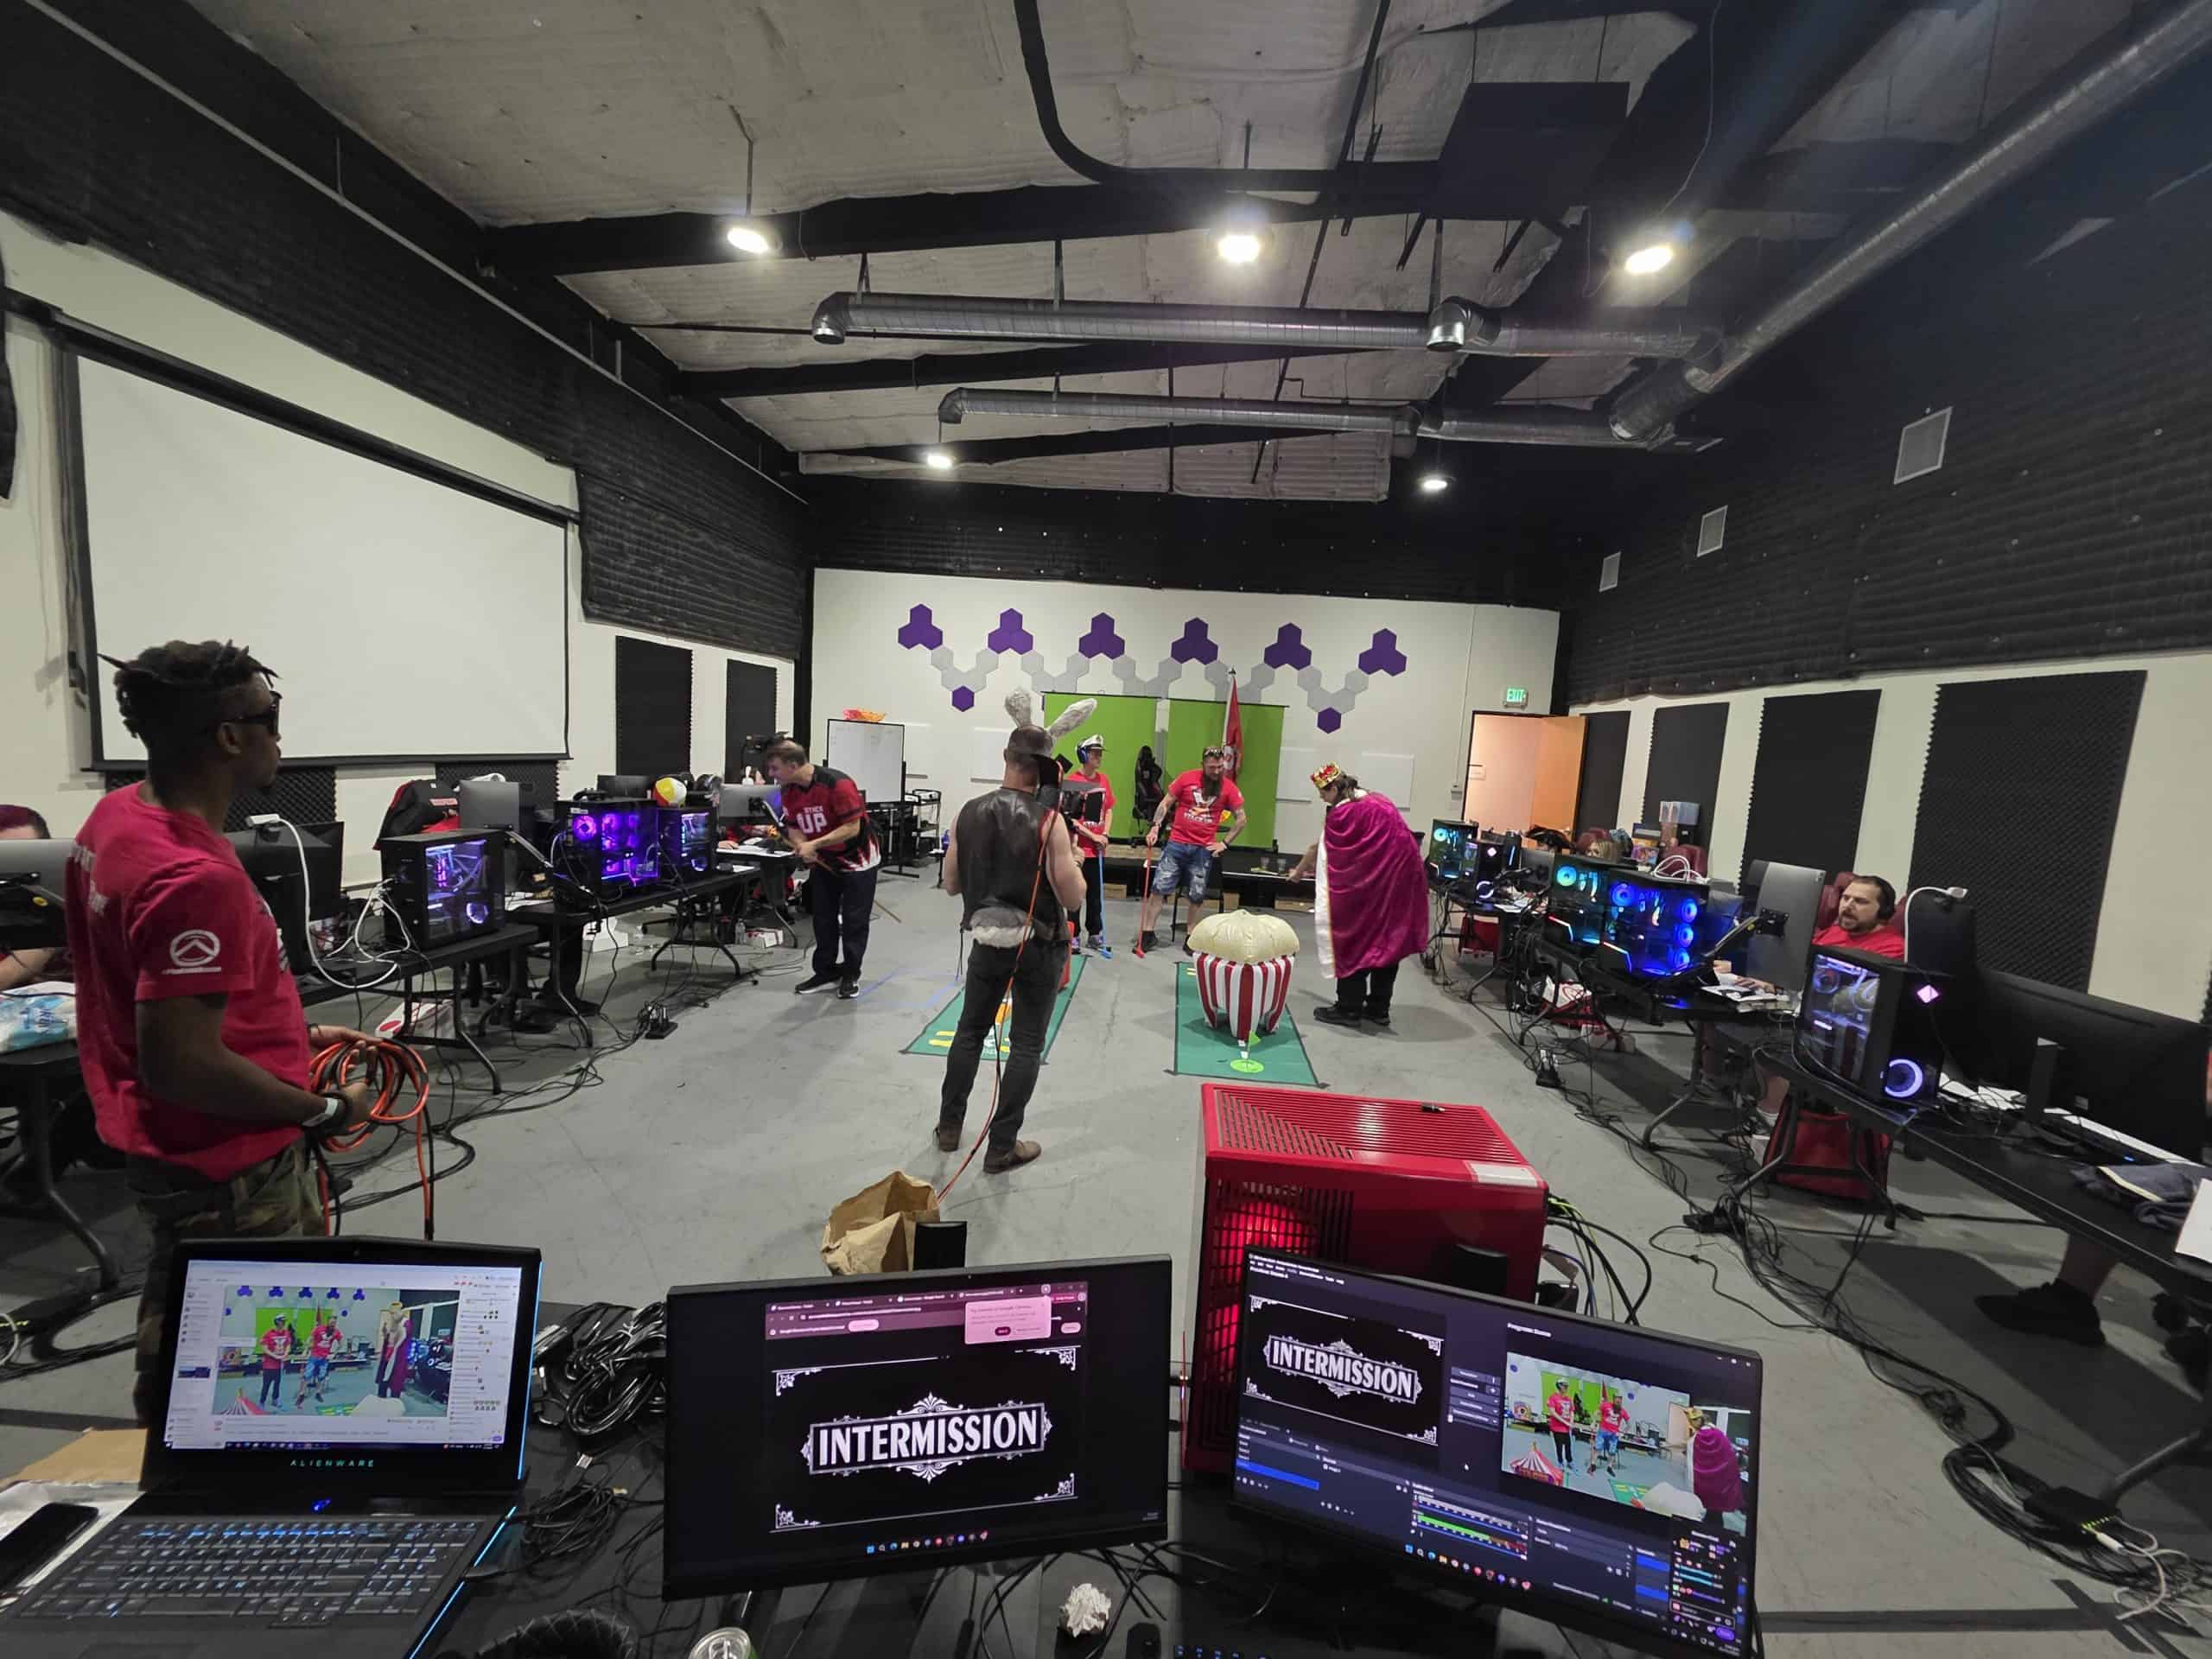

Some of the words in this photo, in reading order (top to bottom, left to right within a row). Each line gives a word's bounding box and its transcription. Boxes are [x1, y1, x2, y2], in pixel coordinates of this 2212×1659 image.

[796, 812, 827, 834] UP
[1272, 1339, 1413, 1399] INTERMISSION
[818, 1408, 1038, 1466] INTERMISSION
[289, 1459, 374, 1467] ALIENWARE
